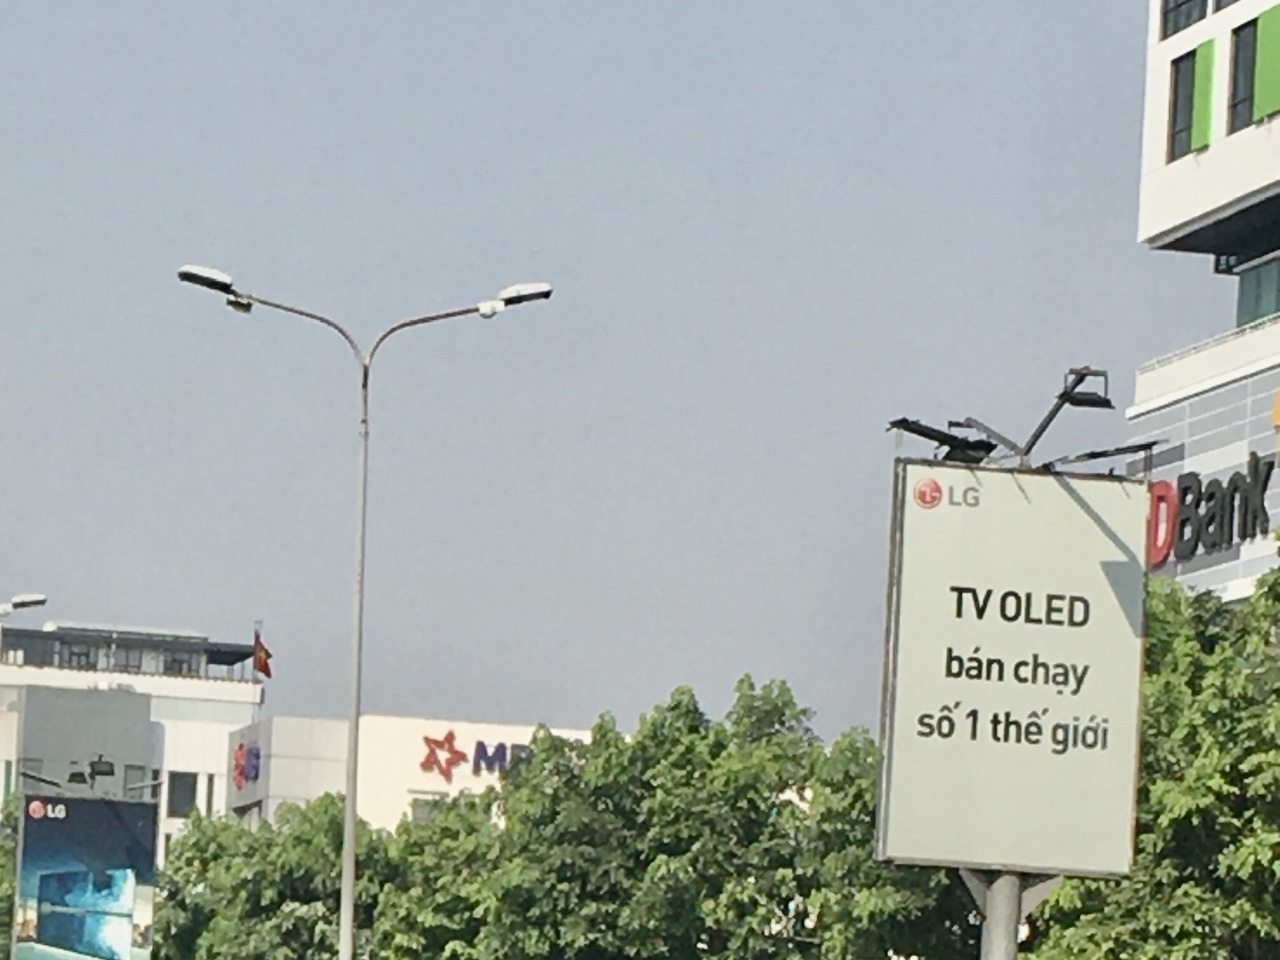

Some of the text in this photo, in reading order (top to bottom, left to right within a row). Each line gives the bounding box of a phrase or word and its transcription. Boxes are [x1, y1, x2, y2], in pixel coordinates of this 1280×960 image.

[948, 486, 980, 508] LG
[949, 586, 1090, 627] TV OLED
[945, 646, 1091, 696] bán chạy
[917, 701, 1109, 755] số 1 thế giới
[47, 803, 66, 819] LG
